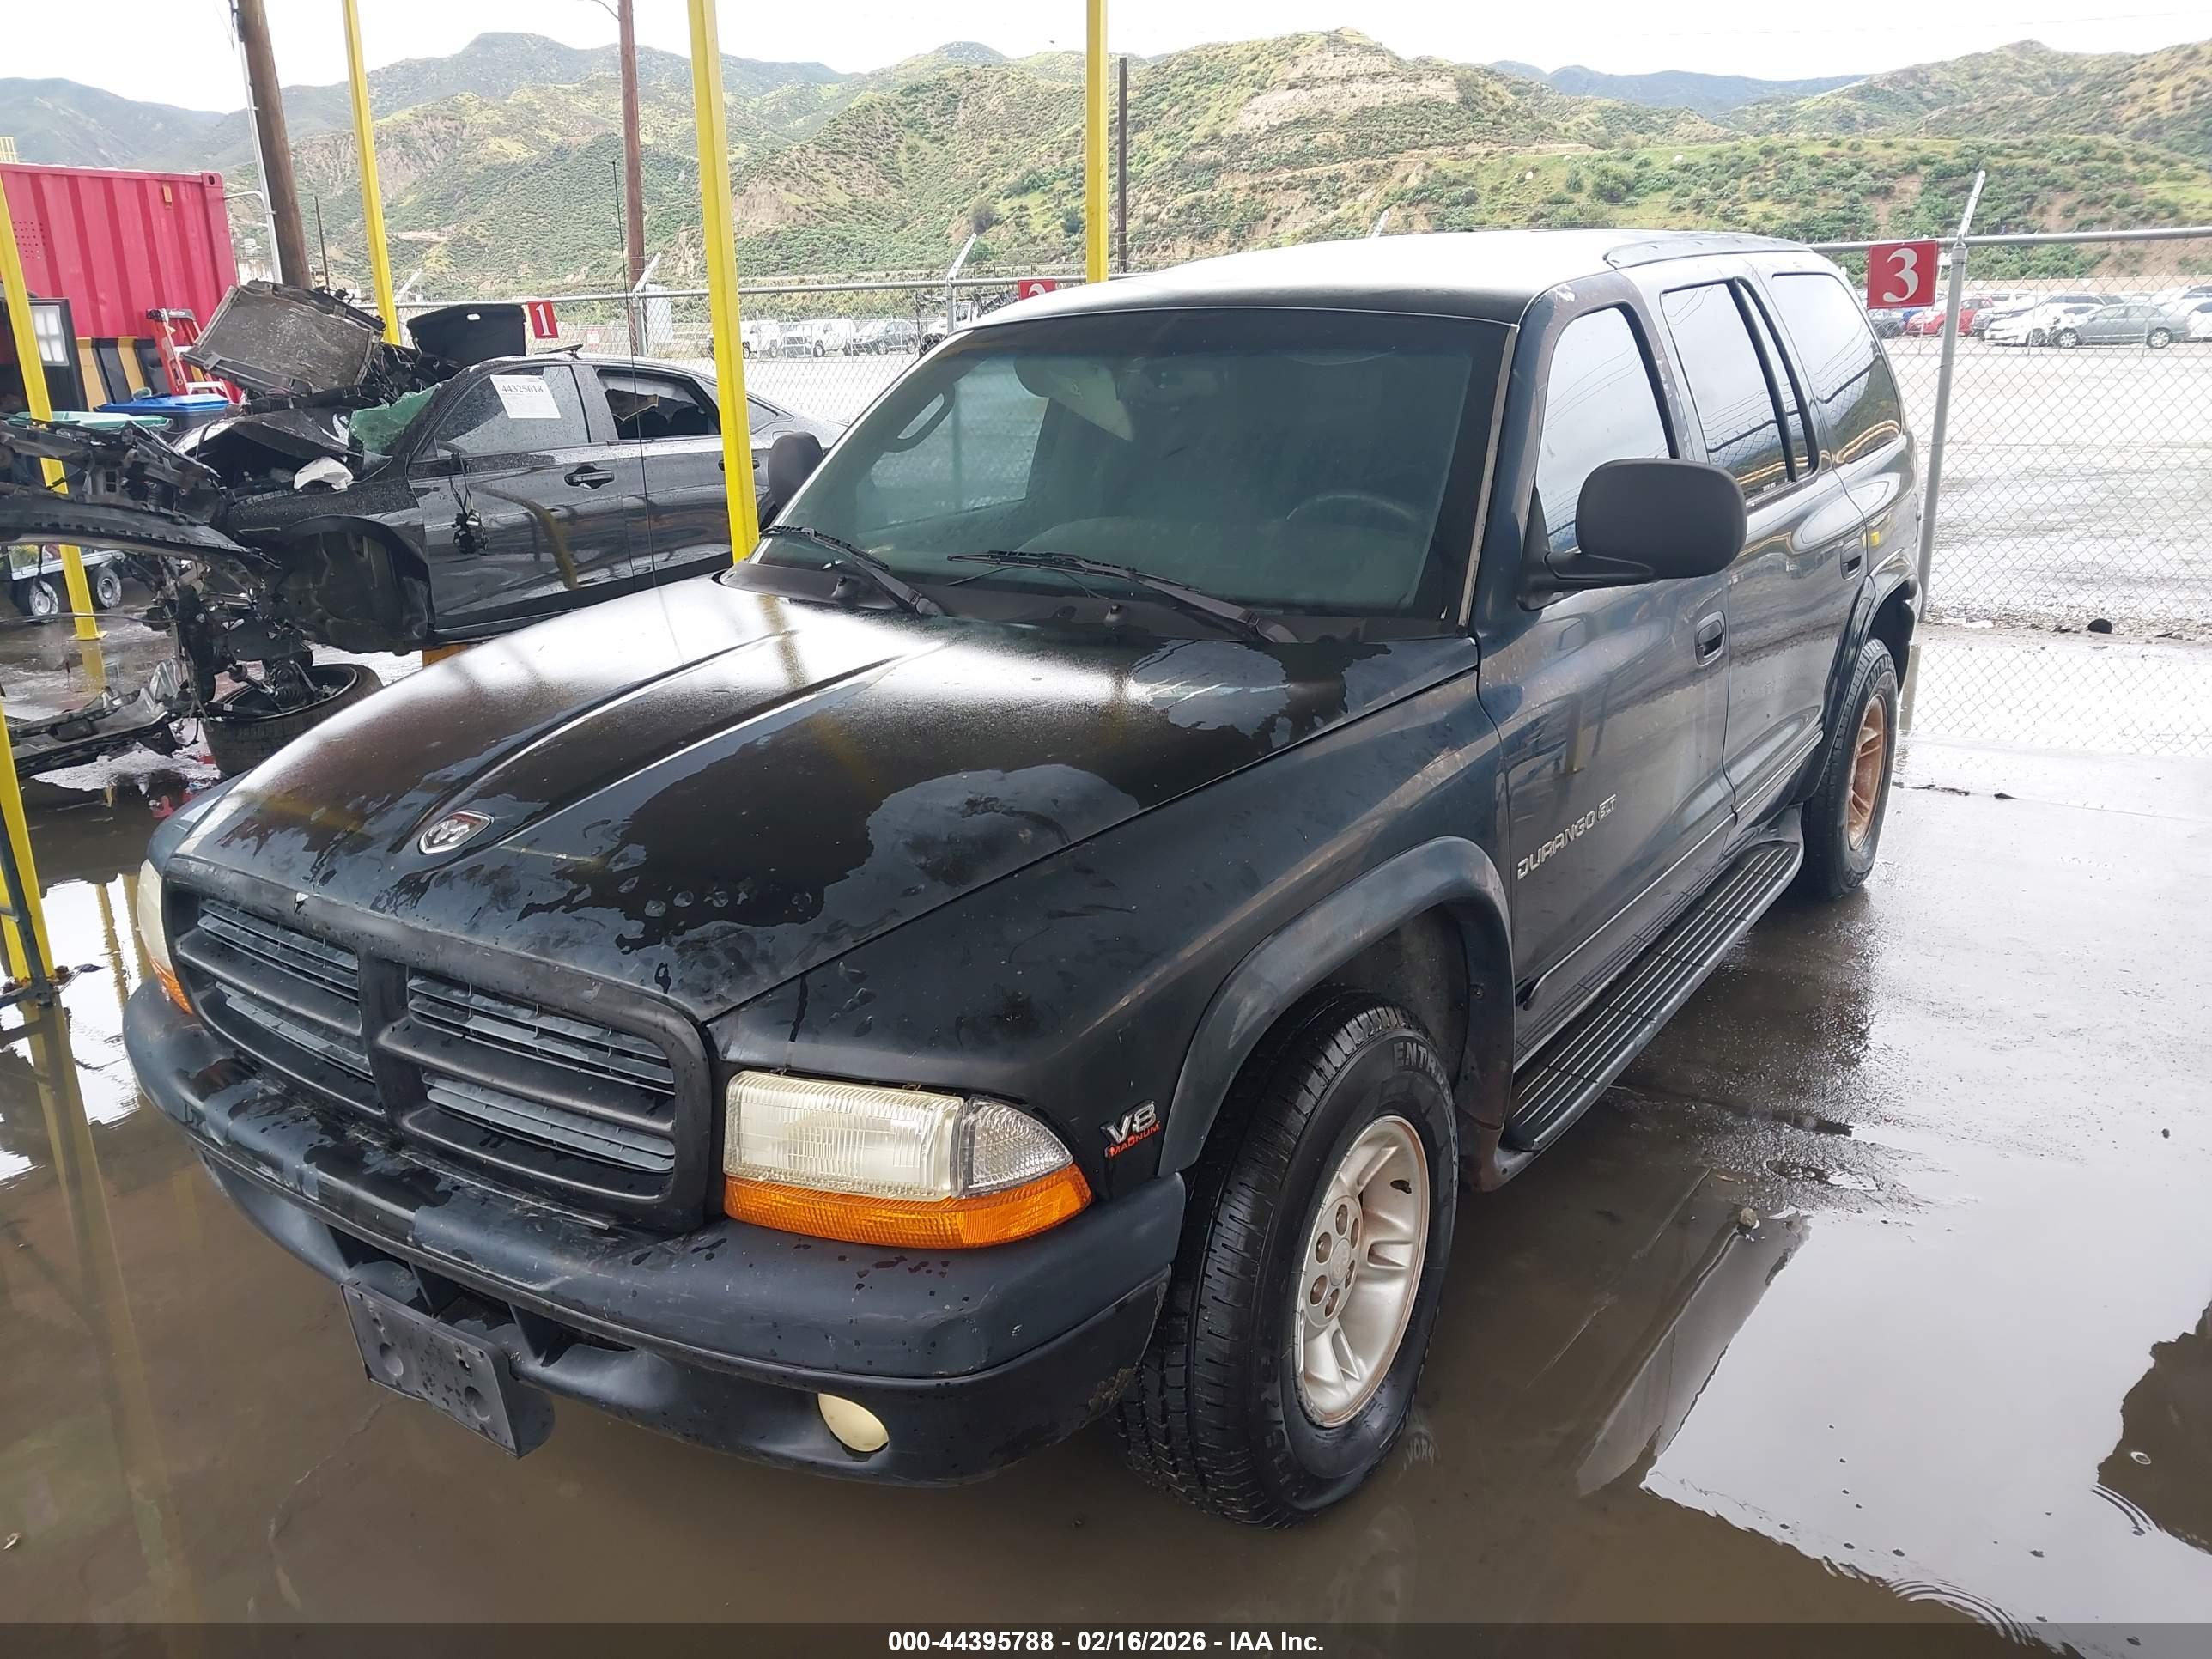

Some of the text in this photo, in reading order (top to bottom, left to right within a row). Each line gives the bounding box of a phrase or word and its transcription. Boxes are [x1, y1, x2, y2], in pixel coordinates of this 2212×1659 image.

[1882, 247, 1919, 302] 3
[535, 303, 553, 337] 1
[1517, 810, 1595, 880] DURANGO
[1100, 1102, 1157, 1144] V8
[1108, 1121, 1160, 1157] MAGNUM
